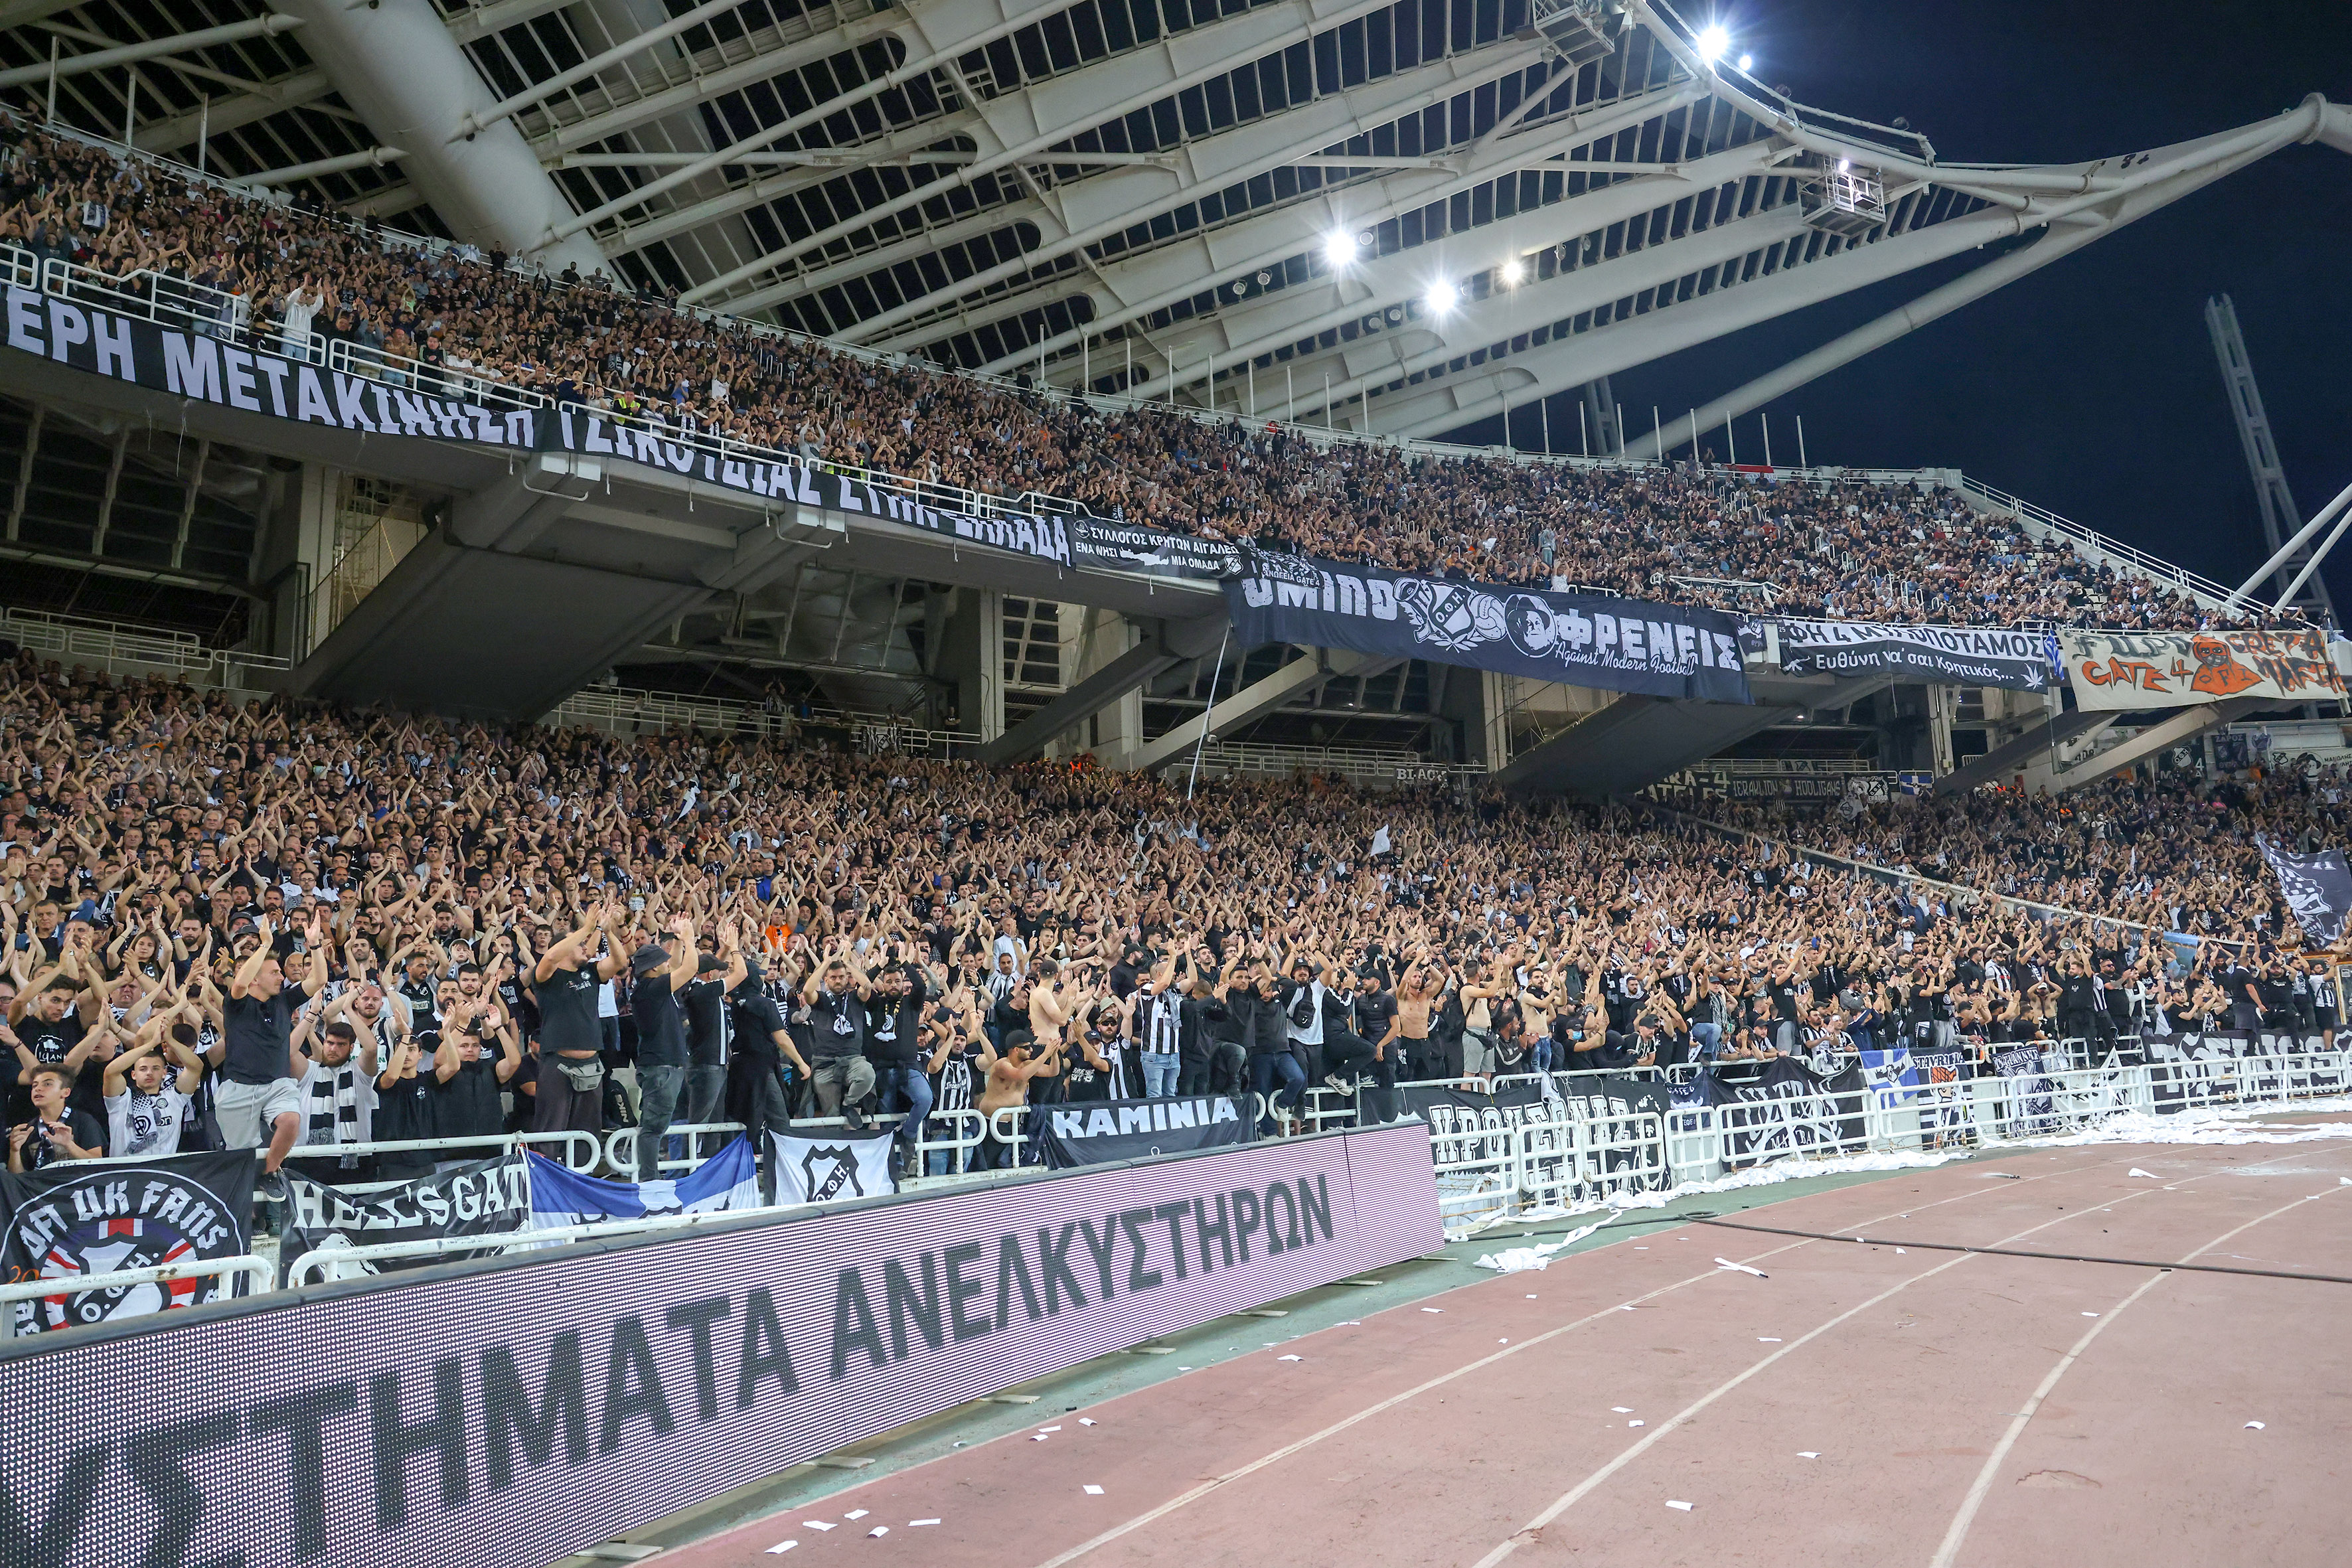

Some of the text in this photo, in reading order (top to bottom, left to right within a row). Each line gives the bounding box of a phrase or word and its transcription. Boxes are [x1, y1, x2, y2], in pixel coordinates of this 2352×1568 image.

[6, 285, 135, 382] ΕΡΗ
[1090, 526, 1148, 545] ΣΥΛΛΟΓΟΣ
[1149, 536, 1190, 551] ΚΡΗΤΩΝ
[1075, 542, 1220, 570] ΕΝΑ ΝΗΣΙ ΜΙΑ ΟΜΑΔΑ
[1296, 576, 1314, 585] GATE
[1832, 627, 1851, 643] 4
[1555, 642, 1695, 676] Against Modern Football
[1816, 651, 1879, 670] Ευθύνη
[1909, 651, 1932, 666] σαι
[2082, 657, 2194, 694] GATE 4
[2199, 667, 2253, 686] OFI
[1794, 780, 1841, 797] HOOLIGANS
[614, 1094, 629, 1123] NIKE
[19, 1180, 228, 1259] OFI UK FANS
[830, 1174, 1335, 1381] ΑΝΕΛΚΥΣΤΗΡΩΝ
